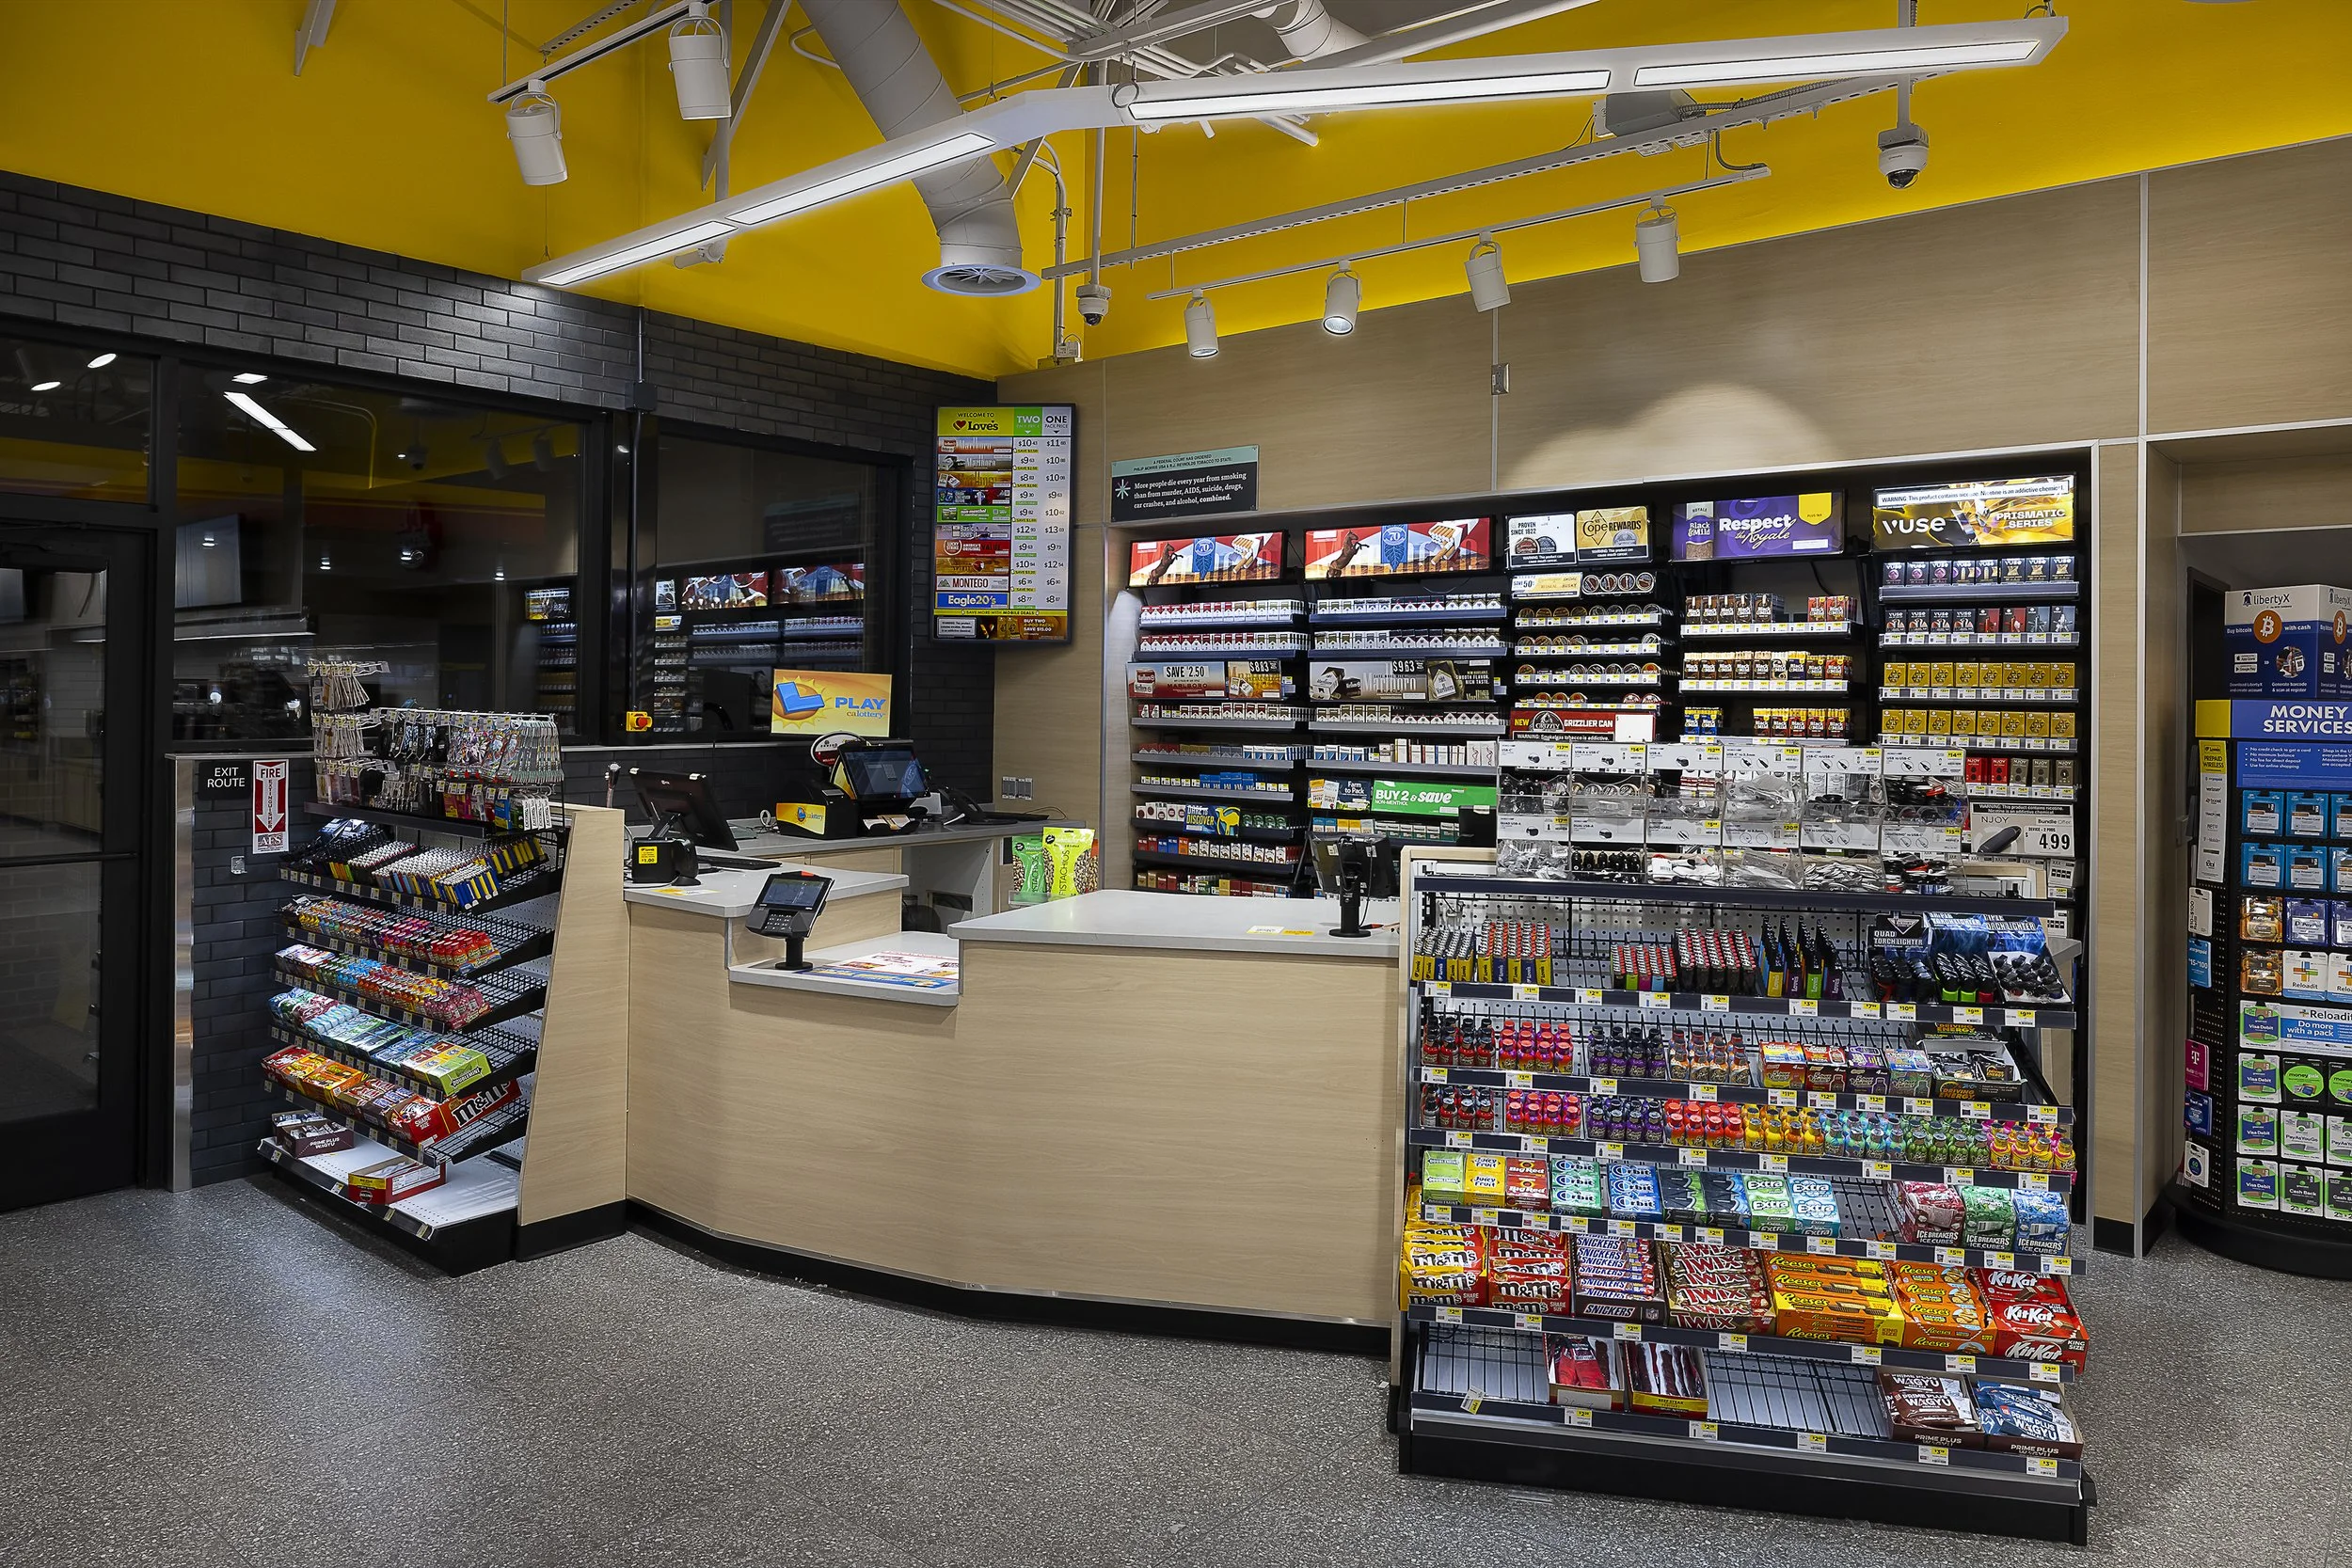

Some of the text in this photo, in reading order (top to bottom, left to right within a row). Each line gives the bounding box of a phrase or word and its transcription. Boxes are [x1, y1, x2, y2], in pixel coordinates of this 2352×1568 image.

[968, 420, 998, 431] Love's
[1150, 481, 1167, 489] people
[1143, 499, 1165, 508] crashes,
[1997, 510, 2065, 520] PRISMATIC
[1583, 520, 1641, 536] Cope REWARDS
[1720, 515, 1791, 532] Respect
[2009, 519, 2053, 528] SERIES
[953, 578, 988, 587] MONTEGO
[948, 595, 996, 606] Eagle20's
[2254, 594, 2290, 605] libertyX
[1167, 667, 1184, 677] SAVE
[835, 698, 886, 709] PLAY
[2270, 705, 2348, 719] MONEY
[2264, 721, 2352, 734] SERVICES
[215, 768, 239, 776] EXIT
[261, 768, 280, 778] FIRE
[207, 778, 245, 787] ROUTE
[1375, 790, 1400, 800] BUY
[1401, 791, 1409, 800] 2
[1418, 792, 1452, 803] save
[1186, 815, 1214, 824] DISCOVER
[261, 835, 281, 845] AFS
[453, 1069, 481, 1085] DOUBLEMINT
[415, 1115, 431, 1126] SHARE
[1748, 1180, 1783, 1189] Extra
[1754, 1200, 1787, 1211] Extra
[1978, 1236, 2010, 1245] BREAKERS
[1682, 1256, 1741, 1275] TWIX
[1770, 1257, 1817, 1269] Reese's
[1775, 1275, 1822, 1288] Reese's
[1499, 1281, 1560, 1298] m&m's
[1784, 1293, 1830, 1307] Reese's
[1584, 1304, 1636, 1317] SNICKERS
[1905, 1398, 1952, 1406] WAGYU
